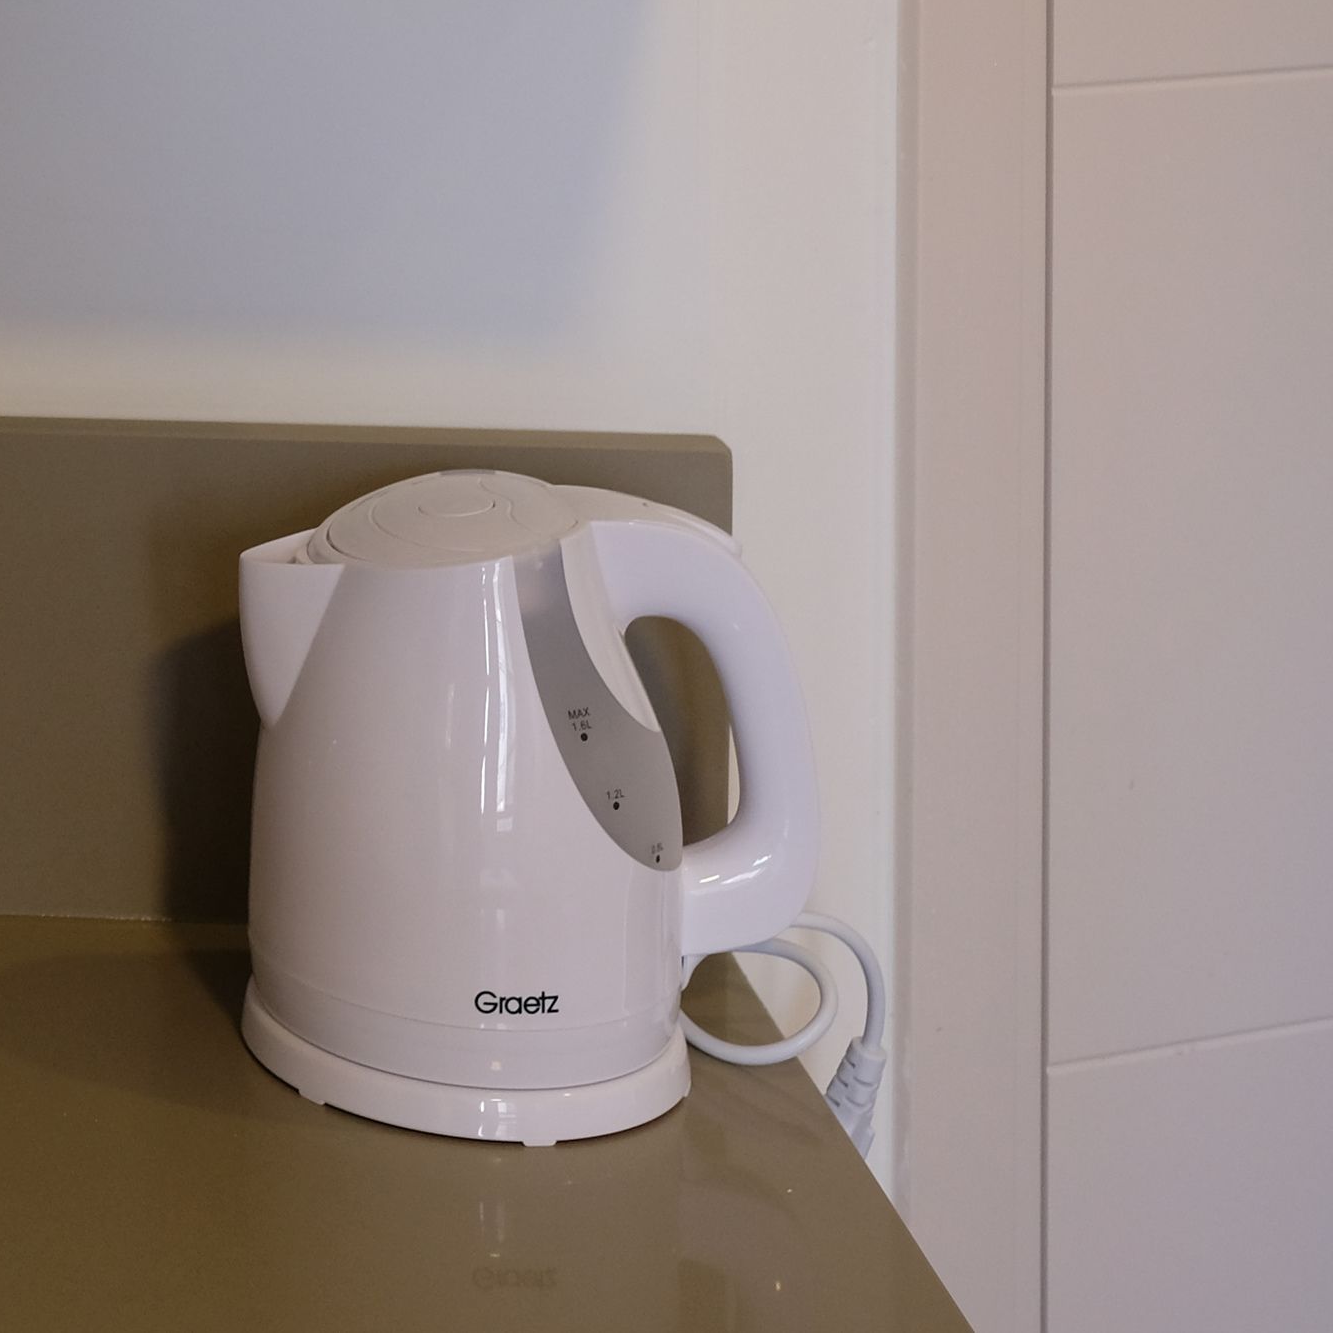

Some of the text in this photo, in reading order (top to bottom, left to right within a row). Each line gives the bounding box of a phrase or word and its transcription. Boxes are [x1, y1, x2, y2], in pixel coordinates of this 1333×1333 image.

[568, 707, 590, 719] MAX
[607, 789, 625, 799] 1.2L
[474, 990, 559, 1014] Graetz
